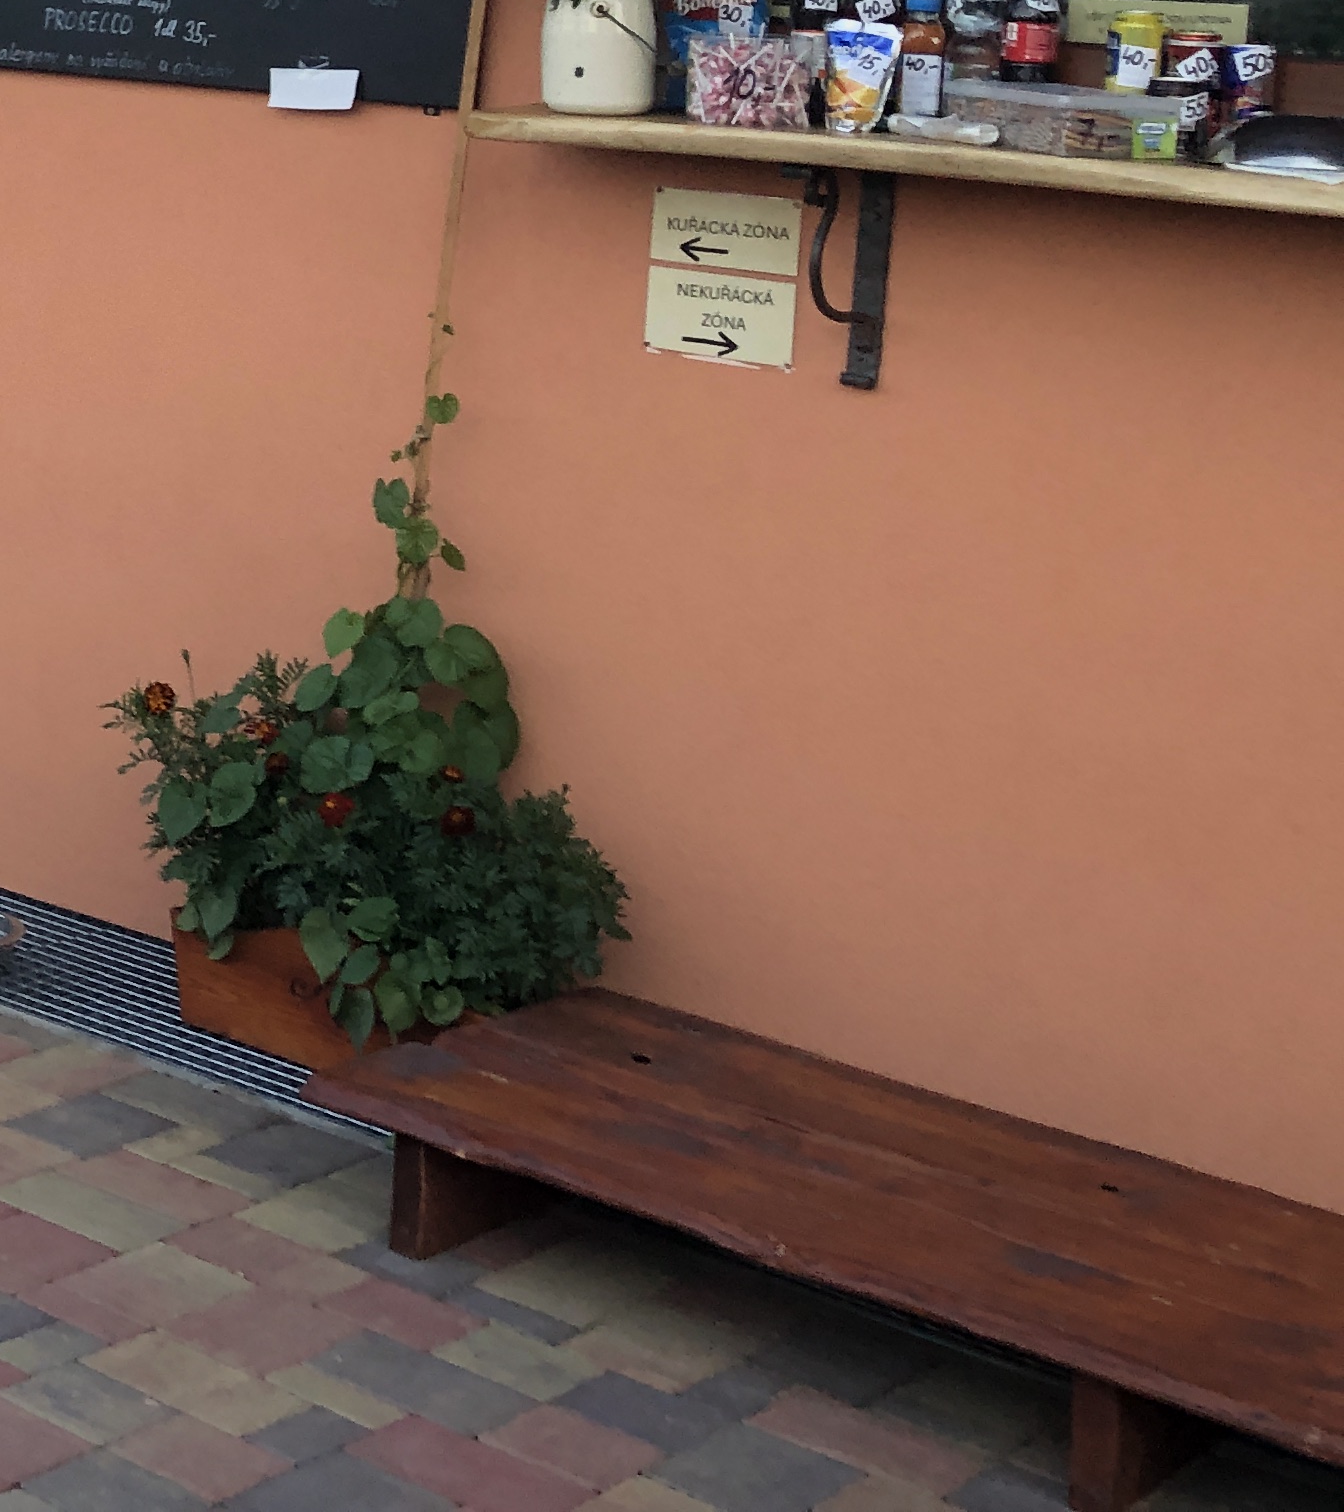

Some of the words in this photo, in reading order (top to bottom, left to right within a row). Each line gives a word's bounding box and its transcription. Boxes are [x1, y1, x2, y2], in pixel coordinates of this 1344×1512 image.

[43, 6, 134, 36] PROSECCO
[182, 19, 218, 47] 35,-
[667, 215, 740, 238] KUŘÁCKÁ
[742, 221, 790, 240] ZÓNA
[676, 282, 774, 306] NEKUŘÁCKÁ
[701, 313, 746, 332] ZÓNA
